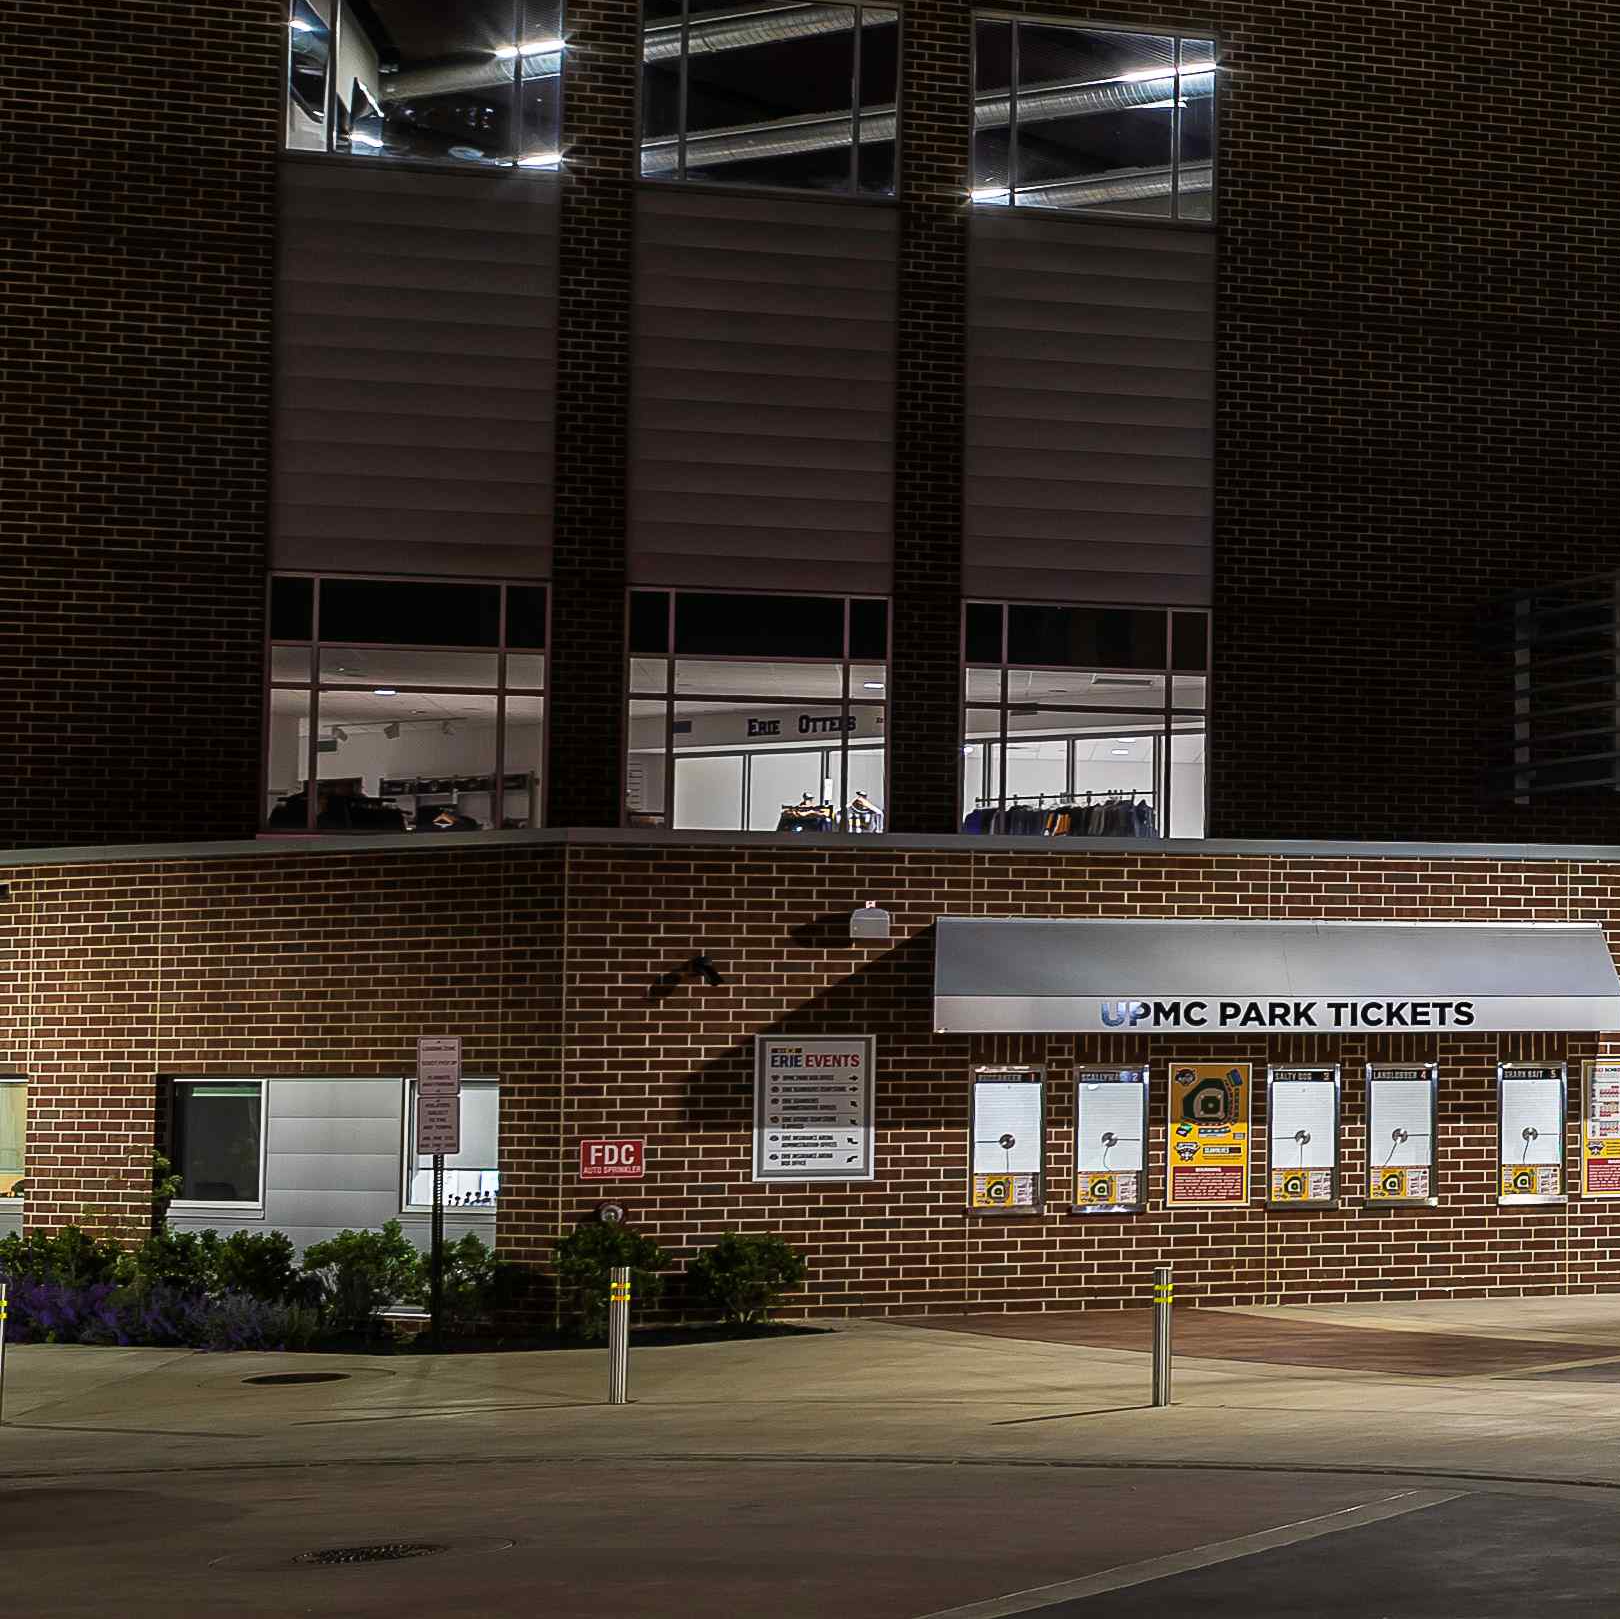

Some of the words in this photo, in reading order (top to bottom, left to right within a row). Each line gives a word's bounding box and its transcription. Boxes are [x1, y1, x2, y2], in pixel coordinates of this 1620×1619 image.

[747, 718, 781, 736] ERIE
[799, 715, 856, 733] OTTES
[1101, 1001, 1207, 1026] UPMC
[1219, 1001, 1317, 1026] PARK
[1327, 1001, 1475, 1026] TICKETS
[771, 1054, 803, 1068] ERIE
[805, 1054, 860, 1068] EVENTS
[1421, 1071, 1426, 1079] 4
[1527, 1070, 1544, 1078] BAIT
[591, 1145, 634, 1165] FDC
[603, 1165, 641, 1173] SPRINKLER
